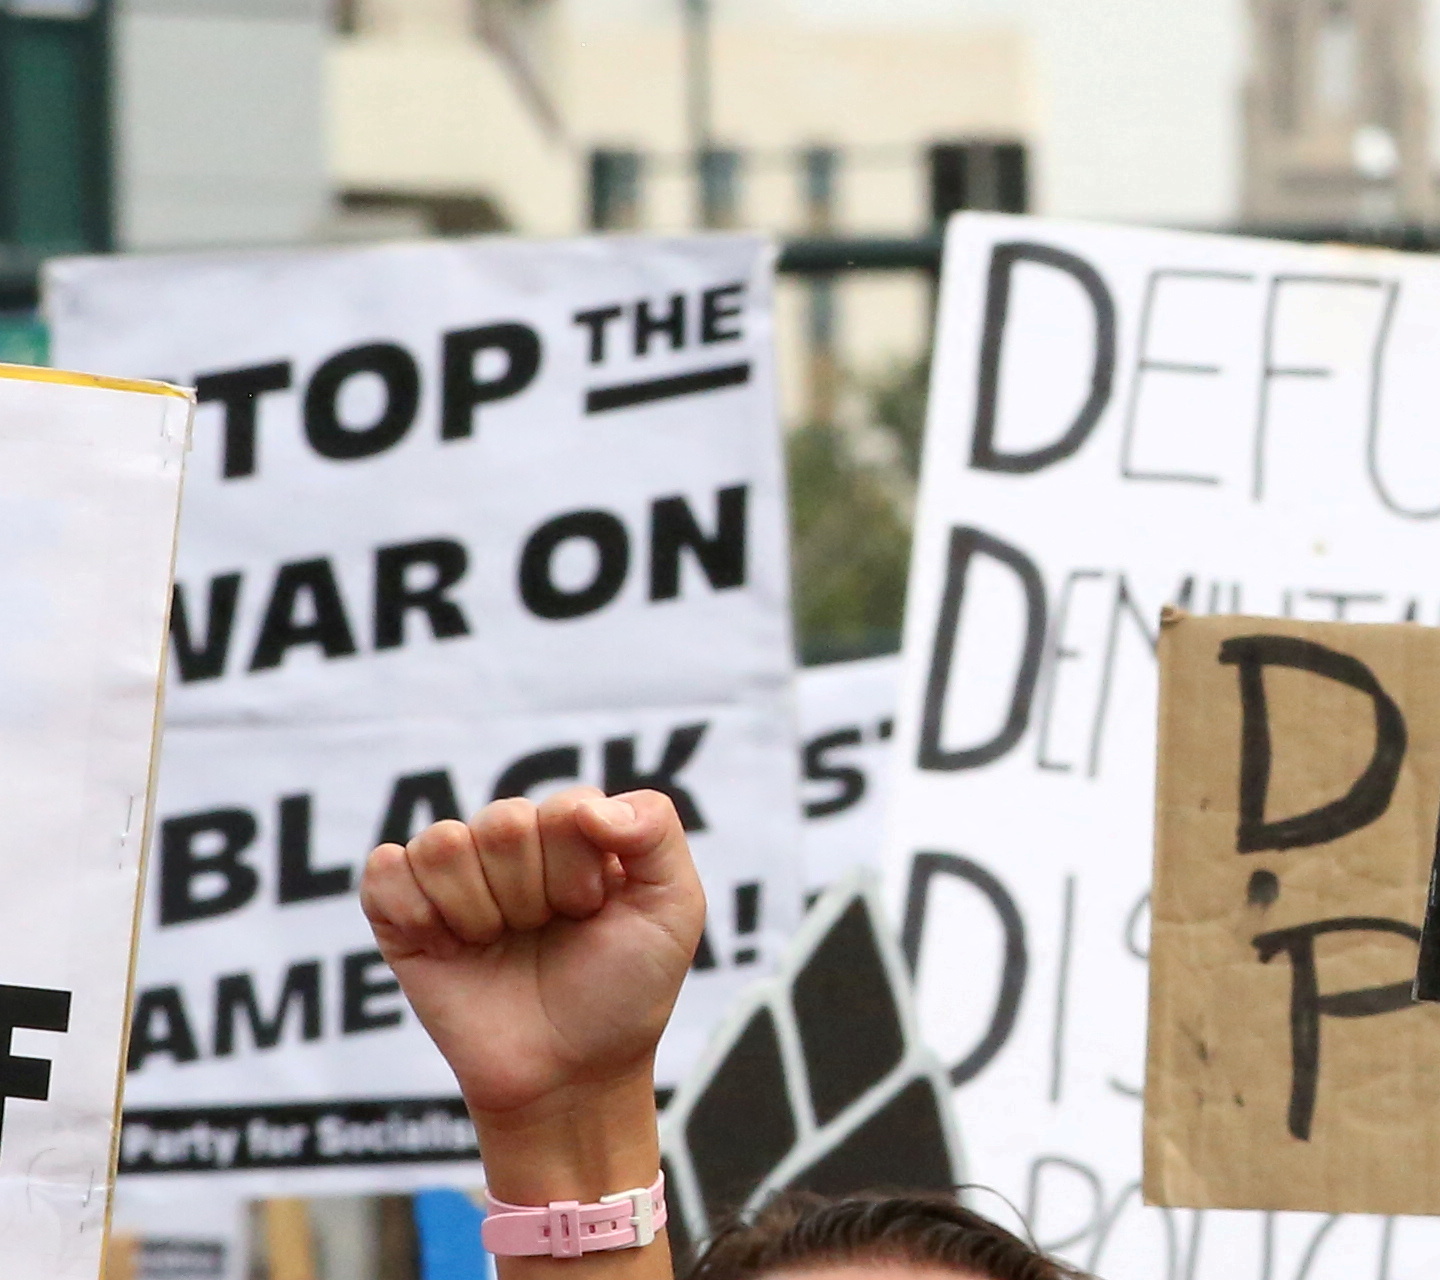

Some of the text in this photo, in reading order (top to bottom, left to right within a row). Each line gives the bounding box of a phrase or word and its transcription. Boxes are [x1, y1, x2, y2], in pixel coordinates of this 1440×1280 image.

[152, 283, 746, 480] TOP THE
[516, 482, 749, 624] ON
